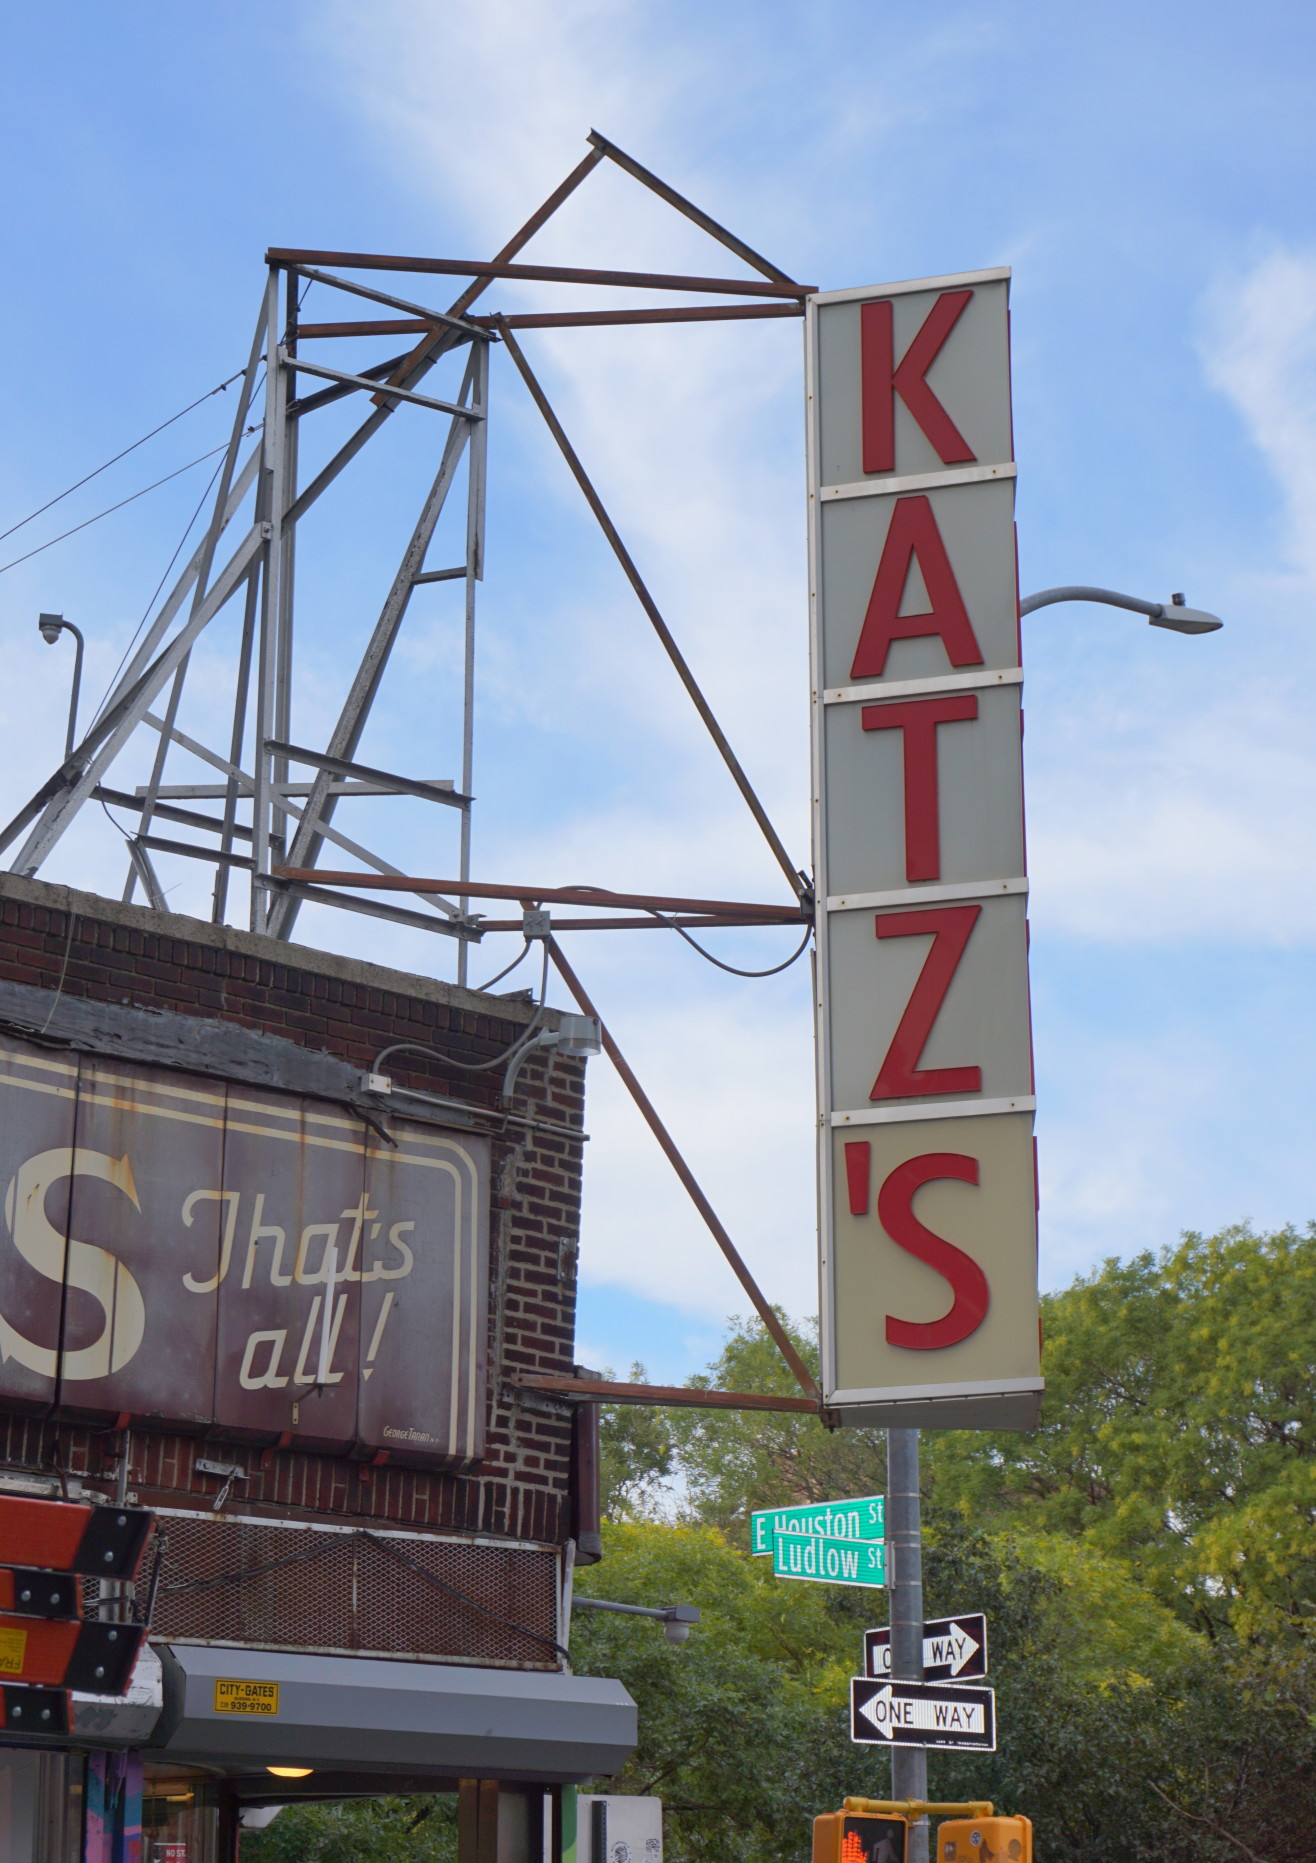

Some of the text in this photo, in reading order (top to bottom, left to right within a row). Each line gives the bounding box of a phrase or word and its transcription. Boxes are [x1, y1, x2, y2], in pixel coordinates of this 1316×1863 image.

[845, 290, 990, 1351] KATZ'S
[181, 1189, 416, 1293] That's
[756, 1517, 766, 1550] E
[868, 1502, 883, 1524] St
[778, 1537, 882, 1579] Ludlow St
[931, 1637, 966, 1664] WAY
[220, 1683, 274, 1698] CITY-GATES
[875, 1700, 975, 1729] ONE WAY
